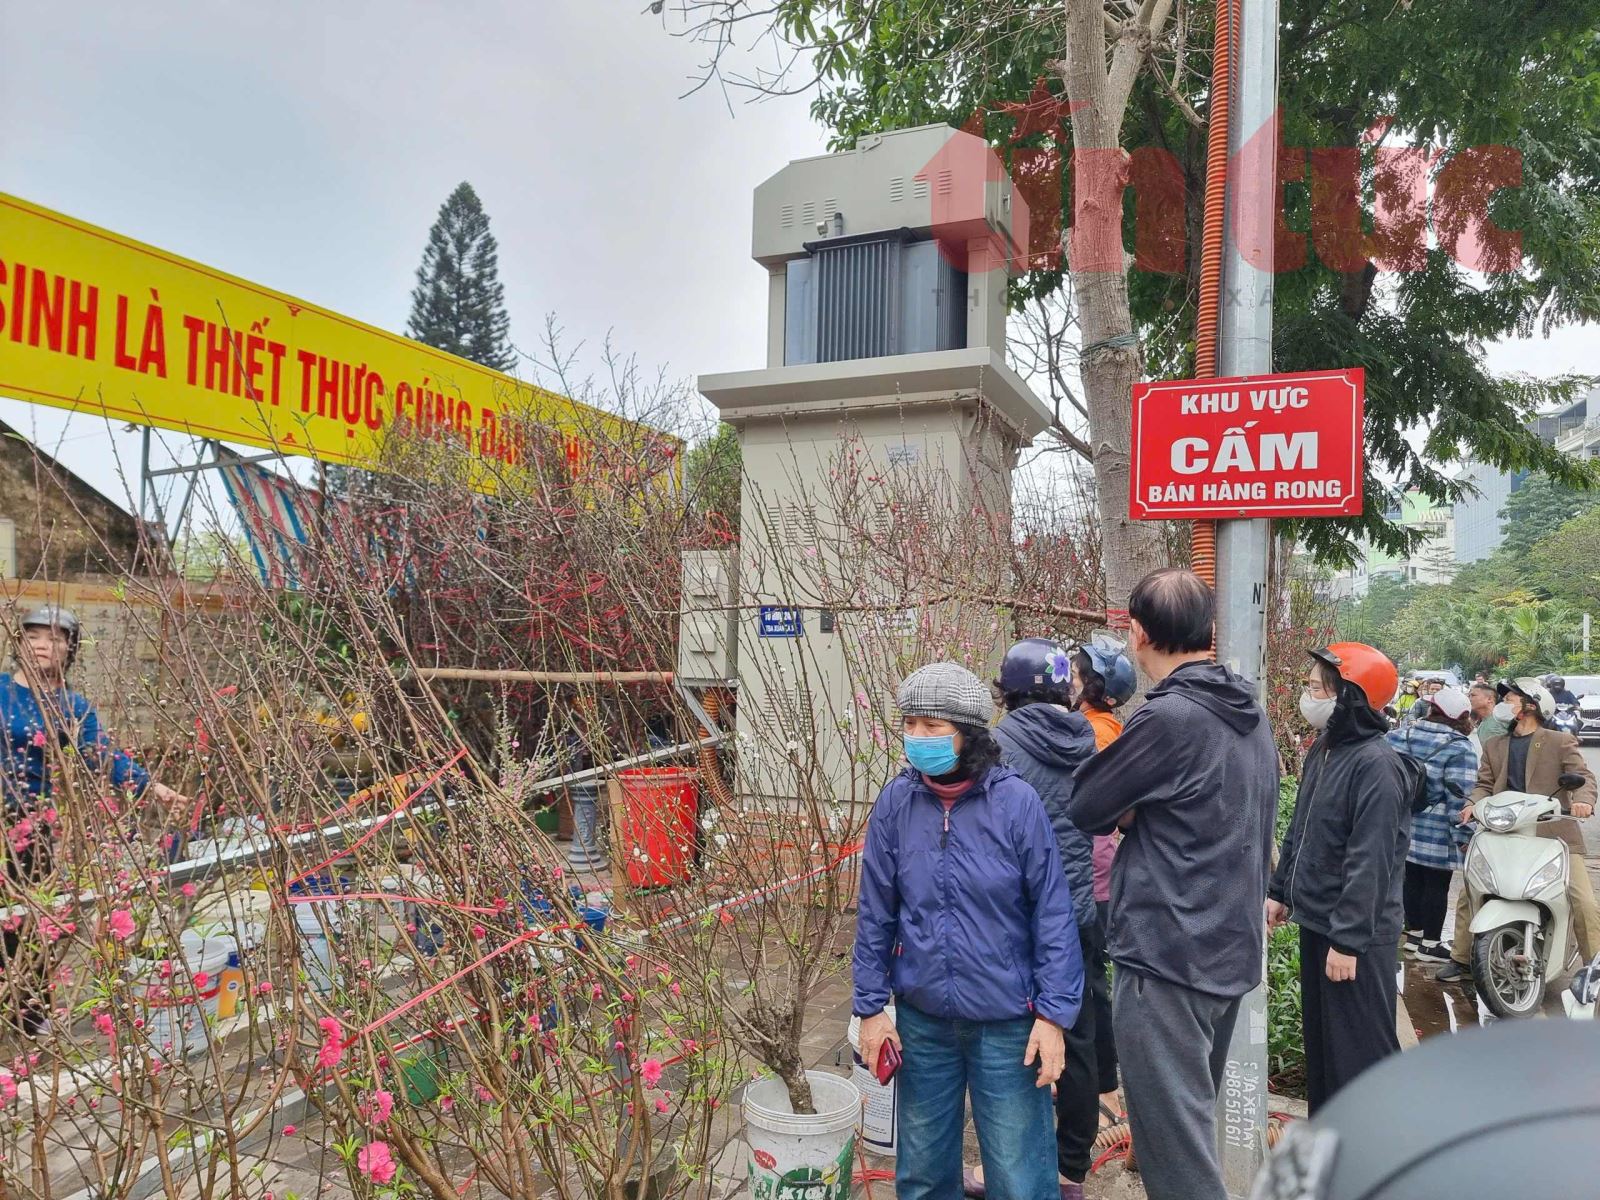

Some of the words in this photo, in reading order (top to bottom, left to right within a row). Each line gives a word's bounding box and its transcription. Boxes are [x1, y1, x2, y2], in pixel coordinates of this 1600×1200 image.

[0, 258, 99, 361] INH
[115, 287, 167, 379] LÀ
[183, 315, 286, 406] THIẾT
[298, 350, 384, 438] THỰC
[1181, 392, 1239, 415] KHU
[1250, 386, 1309, 414] VỰC
[1170, 420, 1318, 475] CẤM
[1149, 481, 1195, 503] BÁN
[1202, 480, 1266, 502] HÀNG
[1274, 479, 1342, 500] RONG
[1243, 1096, 1257, 1115] XE
